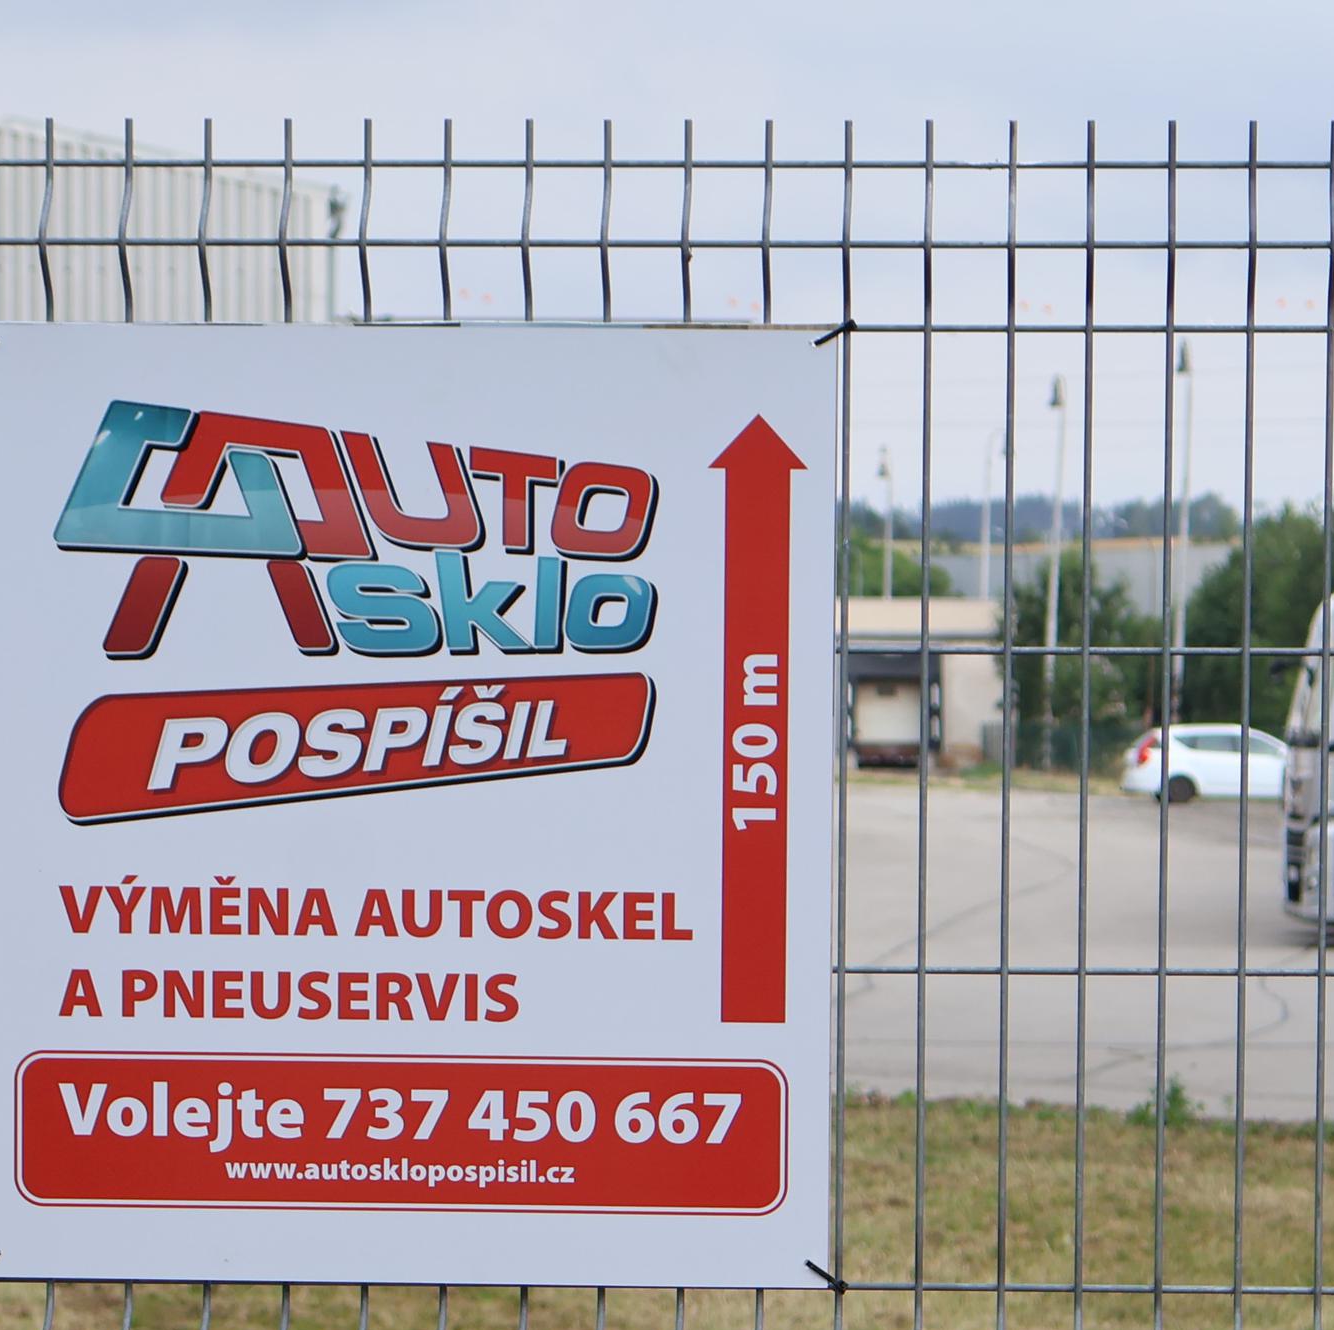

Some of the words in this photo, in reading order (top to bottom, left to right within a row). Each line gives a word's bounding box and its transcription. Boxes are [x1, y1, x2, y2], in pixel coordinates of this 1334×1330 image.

[742, 653, 778, 706] m
[146, 684, 570, 793] POSPÍŠIL
[732, 724, 778, 831] 150
[59, 875, 338, 937] VÝMĚNA
[355, 888, 694, 942] AUTOSKEL
[59, 969, 103, 1018] A
[121, 970, 520, 1023] PNEUSERVIS
[58, 1081, 305, 1153] Volejte
[323, 1087, 450, 1141] 737
[467, 1090, 597, 1143] 450
[614, 1091, 743, 1145] 667
[225, 1157, 575, 1188] www.autosklopospisil.cz
